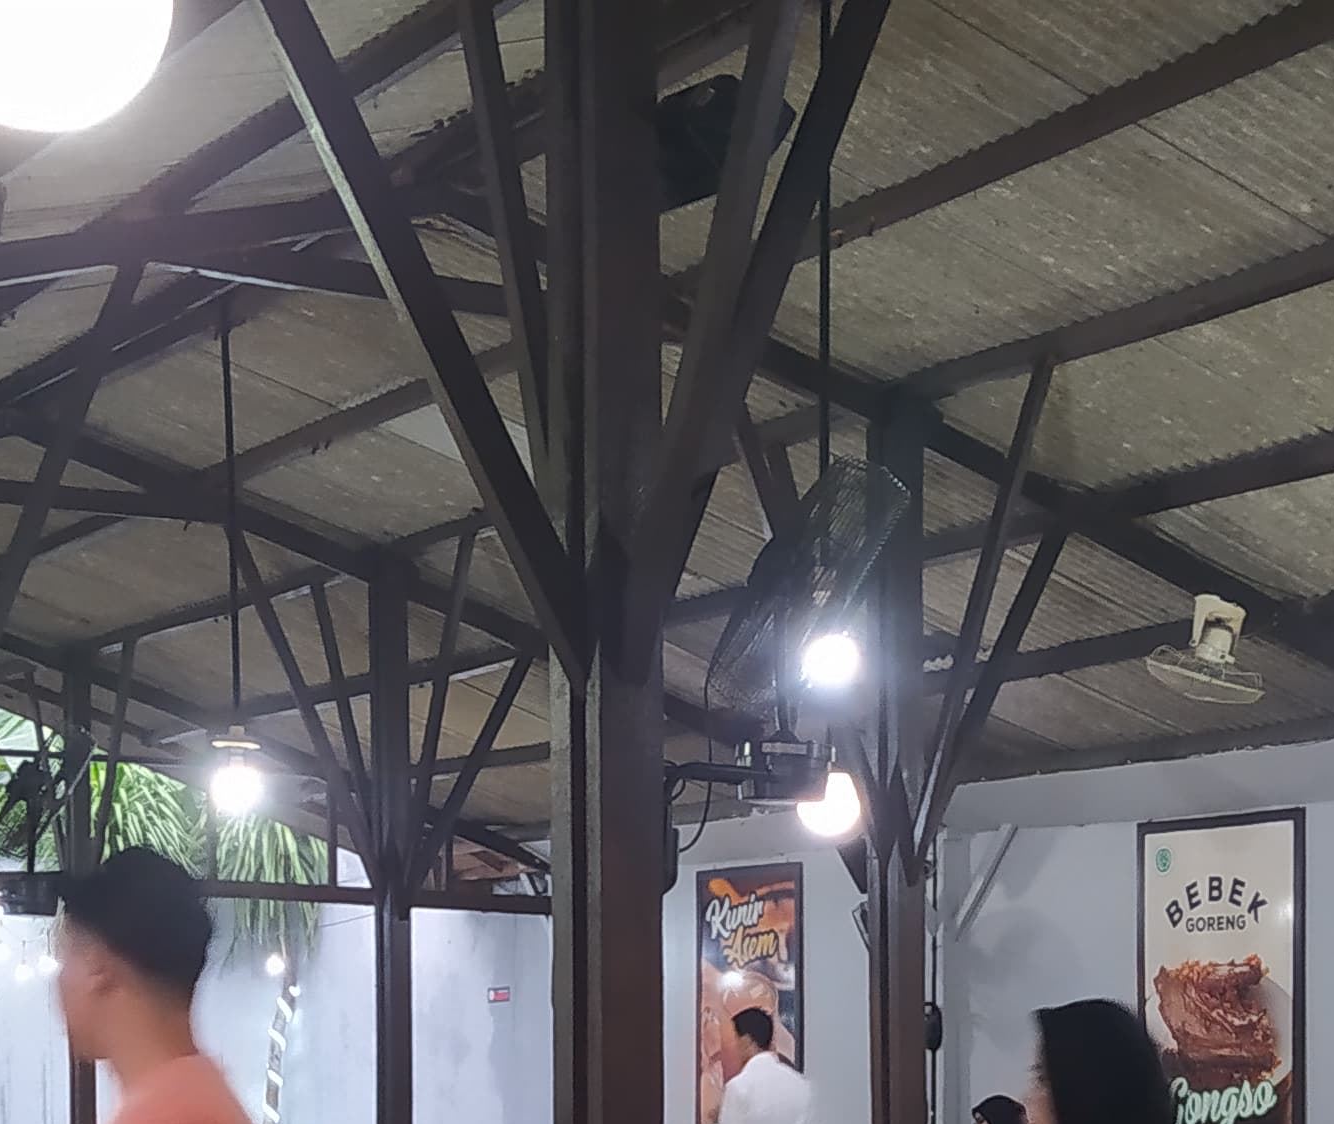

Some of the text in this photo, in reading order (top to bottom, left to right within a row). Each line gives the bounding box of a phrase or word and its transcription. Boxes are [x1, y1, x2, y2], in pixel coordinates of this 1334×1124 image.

[705, 893, 764, 940] Kunir
[1165, 875, 1269, 929] BEBEK
[1185, 913, 1247, 933] GORENG
